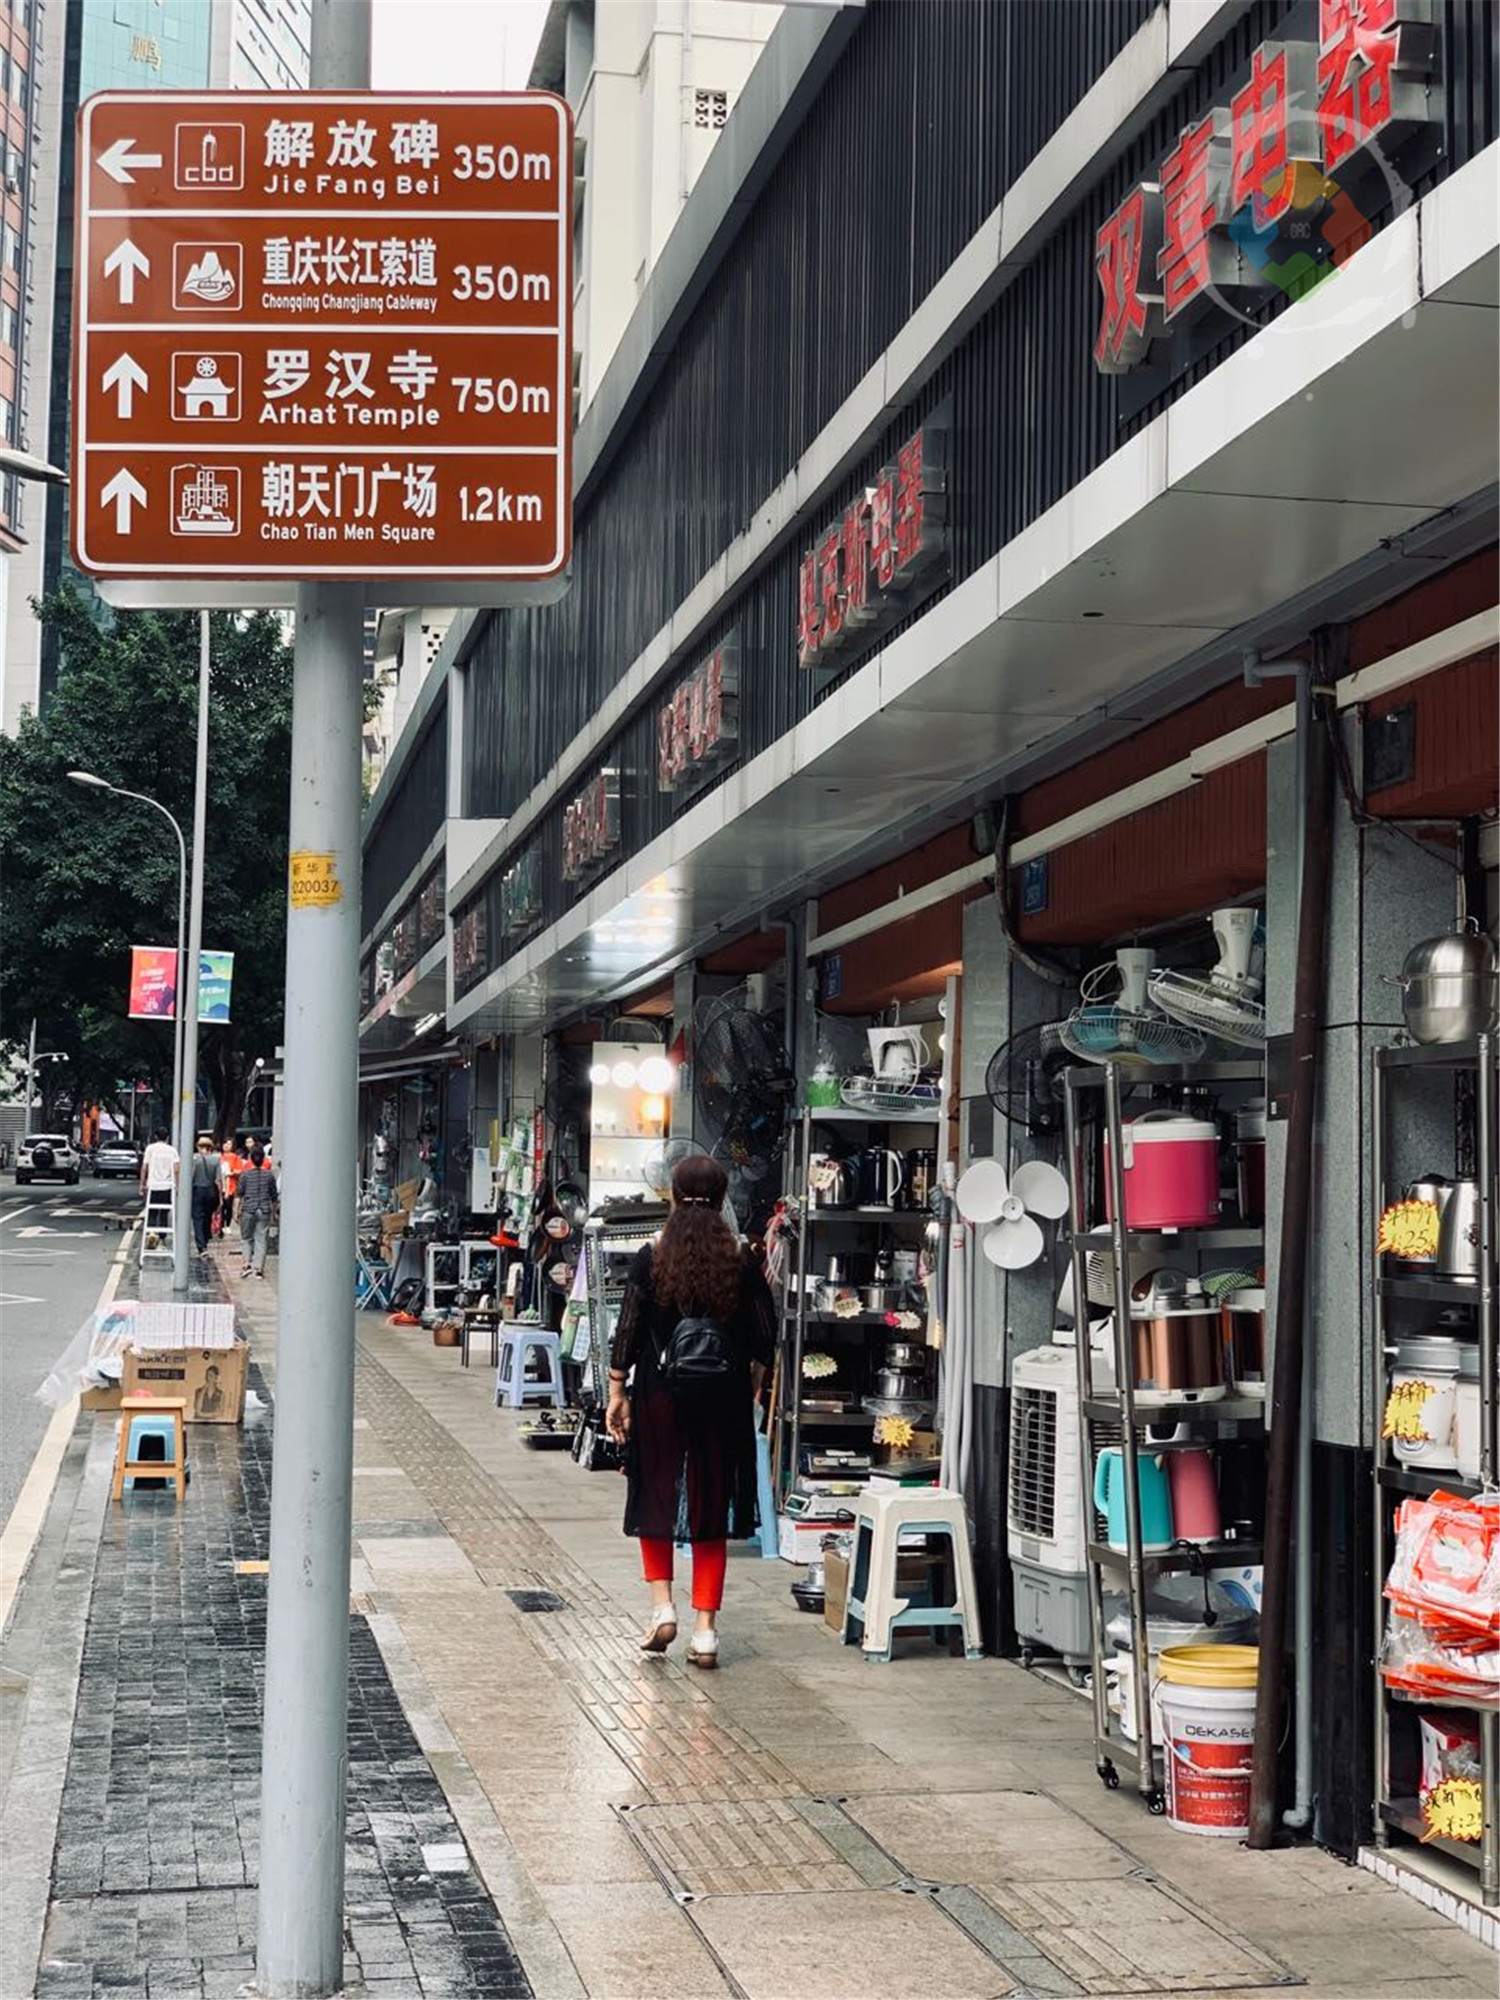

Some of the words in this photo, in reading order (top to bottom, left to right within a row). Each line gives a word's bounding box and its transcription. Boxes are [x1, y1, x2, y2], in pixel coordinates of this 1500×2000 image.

[264, 119, 439, 168] 解放碑
[453, 145, 550, 180] 350m
[264, 175, 306, 194] Jie
[317, 175, 384, 199] Fang
[397, 176, 438, 194] Bei
[263, 236, 437, 287] 重庆长江索道
[453, 265, 550, 300] 350m
[262, 293, 319, 312] Chongqing
[322, 293, 383, 313] Changjiang
[386, 294, 437, 313] Cableway
[263, 350, 438, 400] 罗汉寺
[452, 378, 549, 412] 750m
[259, 403, 336, 424] Arhat
[343, 404, 439, 429] Temple
[261, 463, 436, 517] 朝天门广场
[460, 487, 541, 521] 1.2km
[261, 523, 299, 539] Chao
[305, 523, 336, 539] Tian
[345, 524, 374, 539] Men
[382, 524, 435, 543] Square
